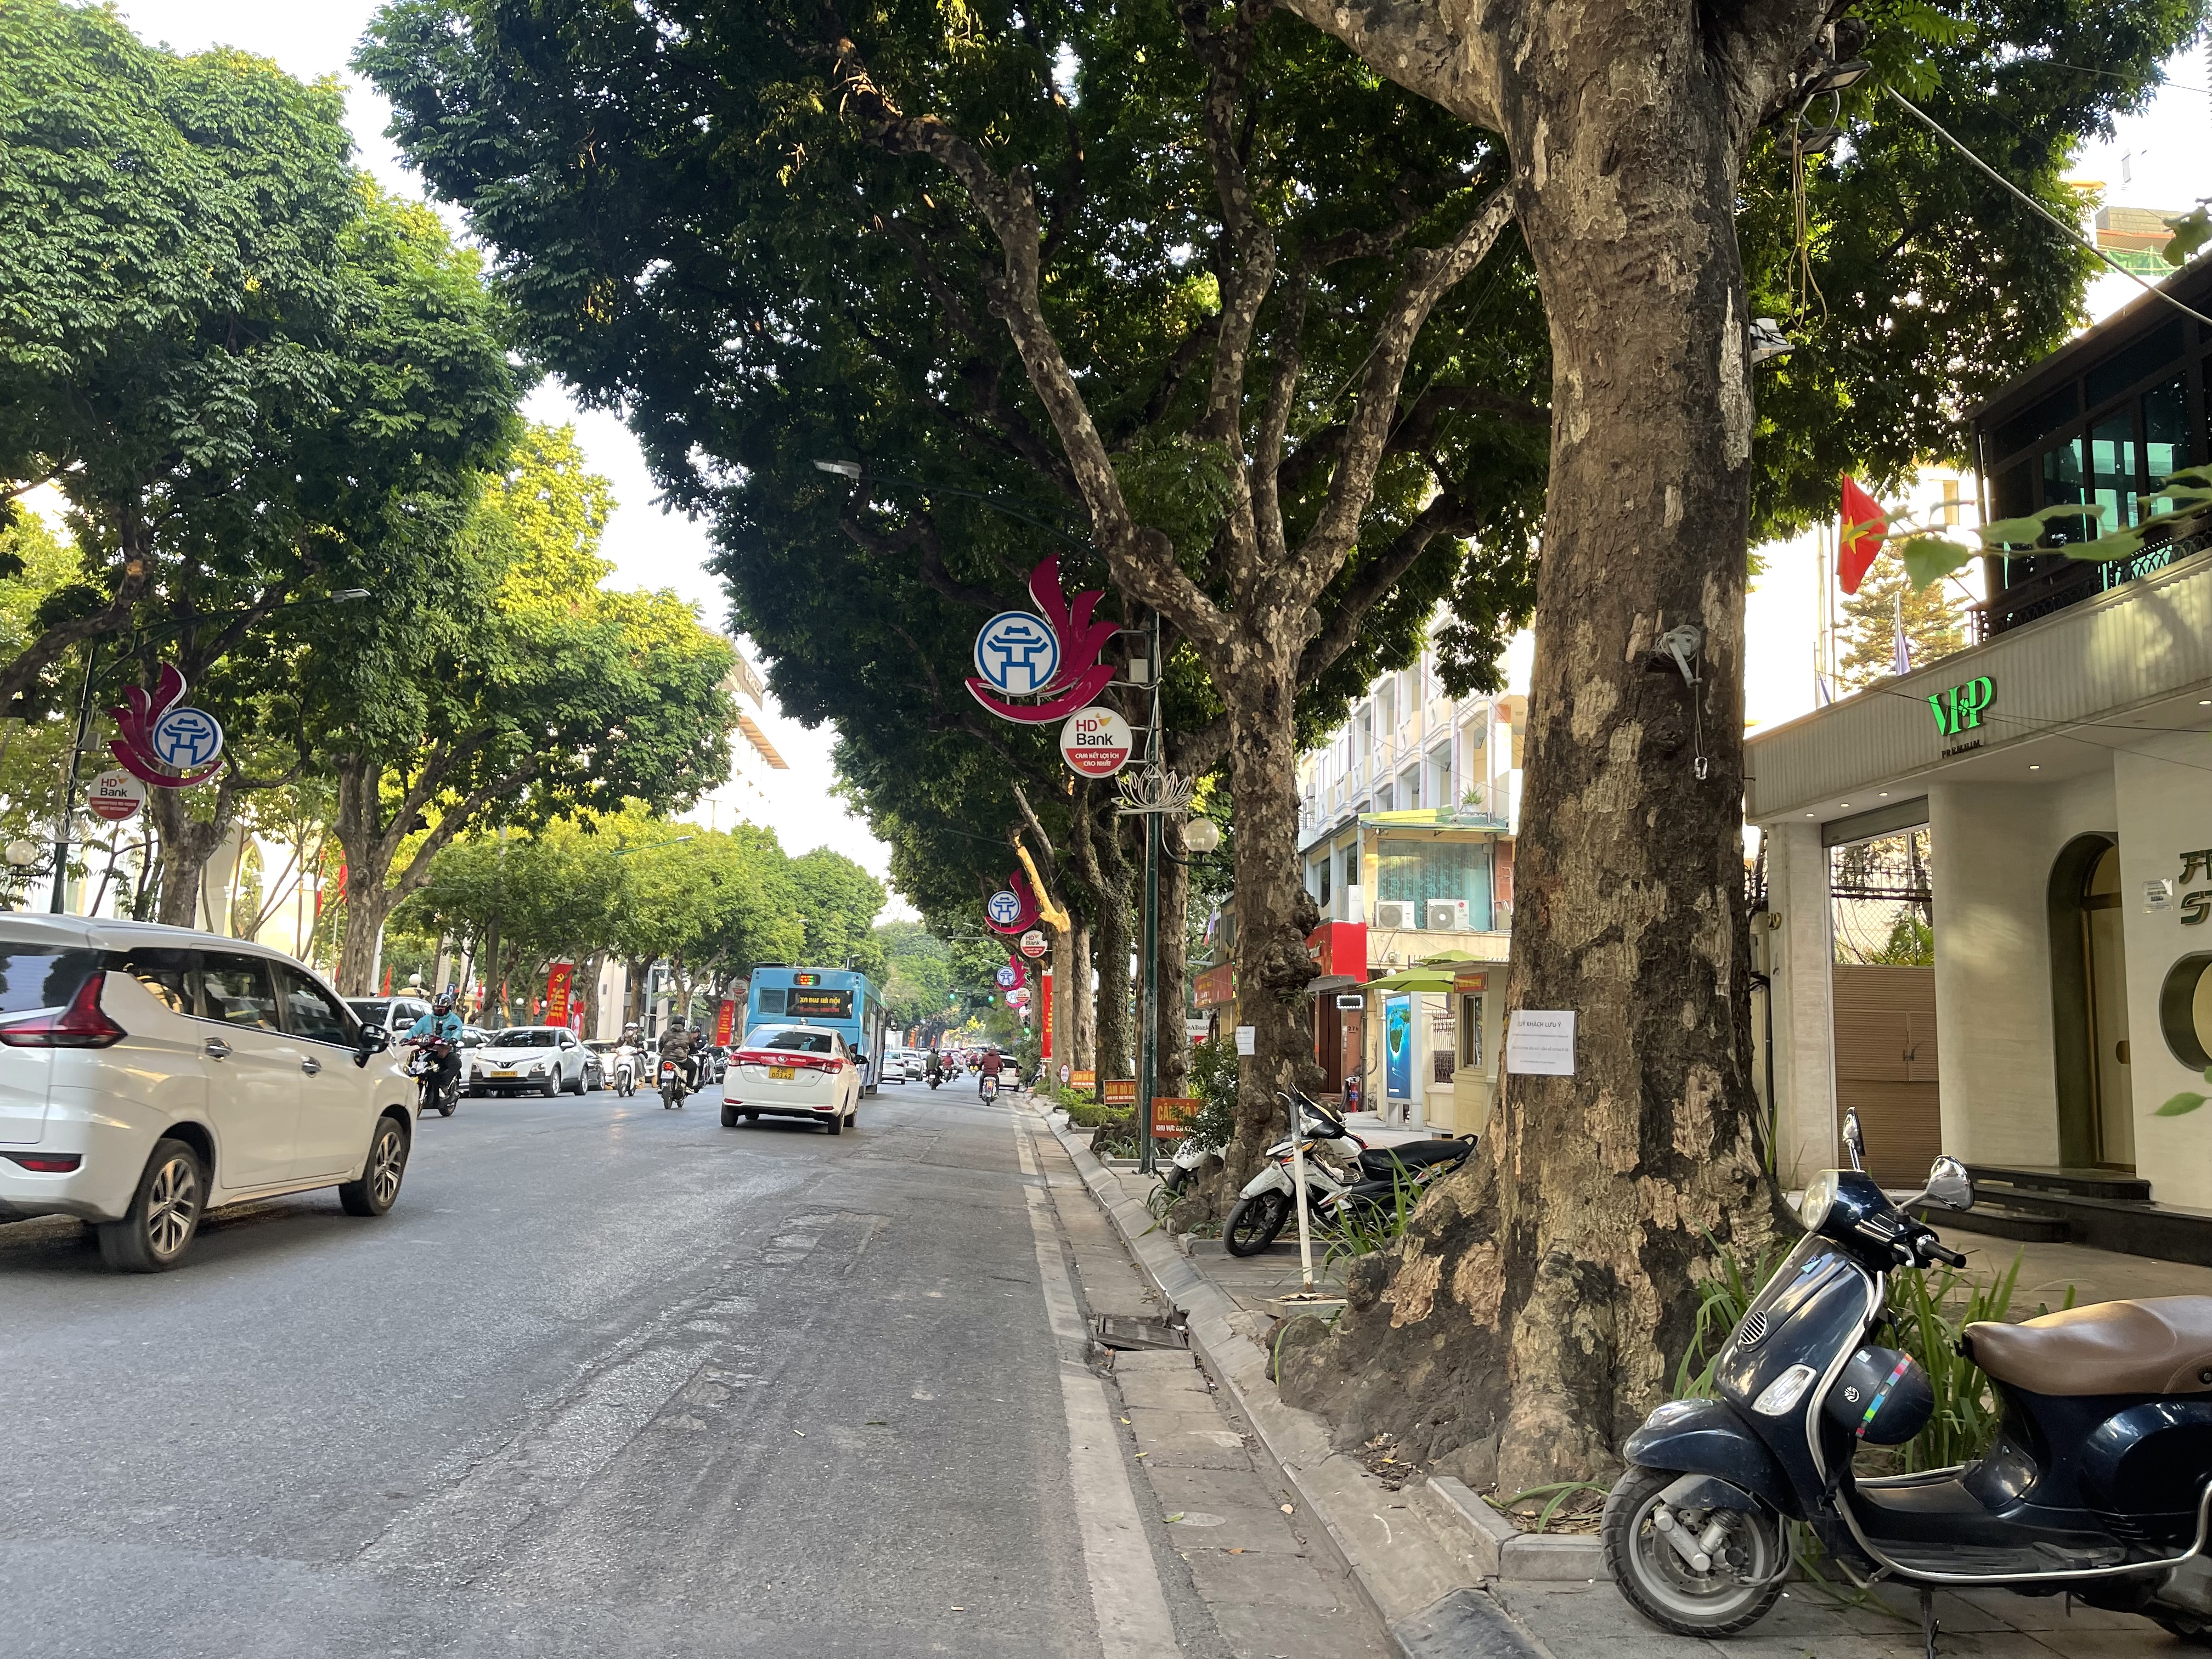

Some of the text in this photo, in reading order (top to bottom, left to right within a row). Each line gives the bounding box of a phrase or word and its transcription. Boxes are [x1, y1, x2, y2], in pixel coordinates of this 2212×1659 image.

[1927, 675, 1993, 736] VIP
[1076, 720, 1097, 732] HD
[1077, 733, 1114, 745] Bank
[101, 778, 117, 787] HD
[100, 788, 127, 797] Bank
